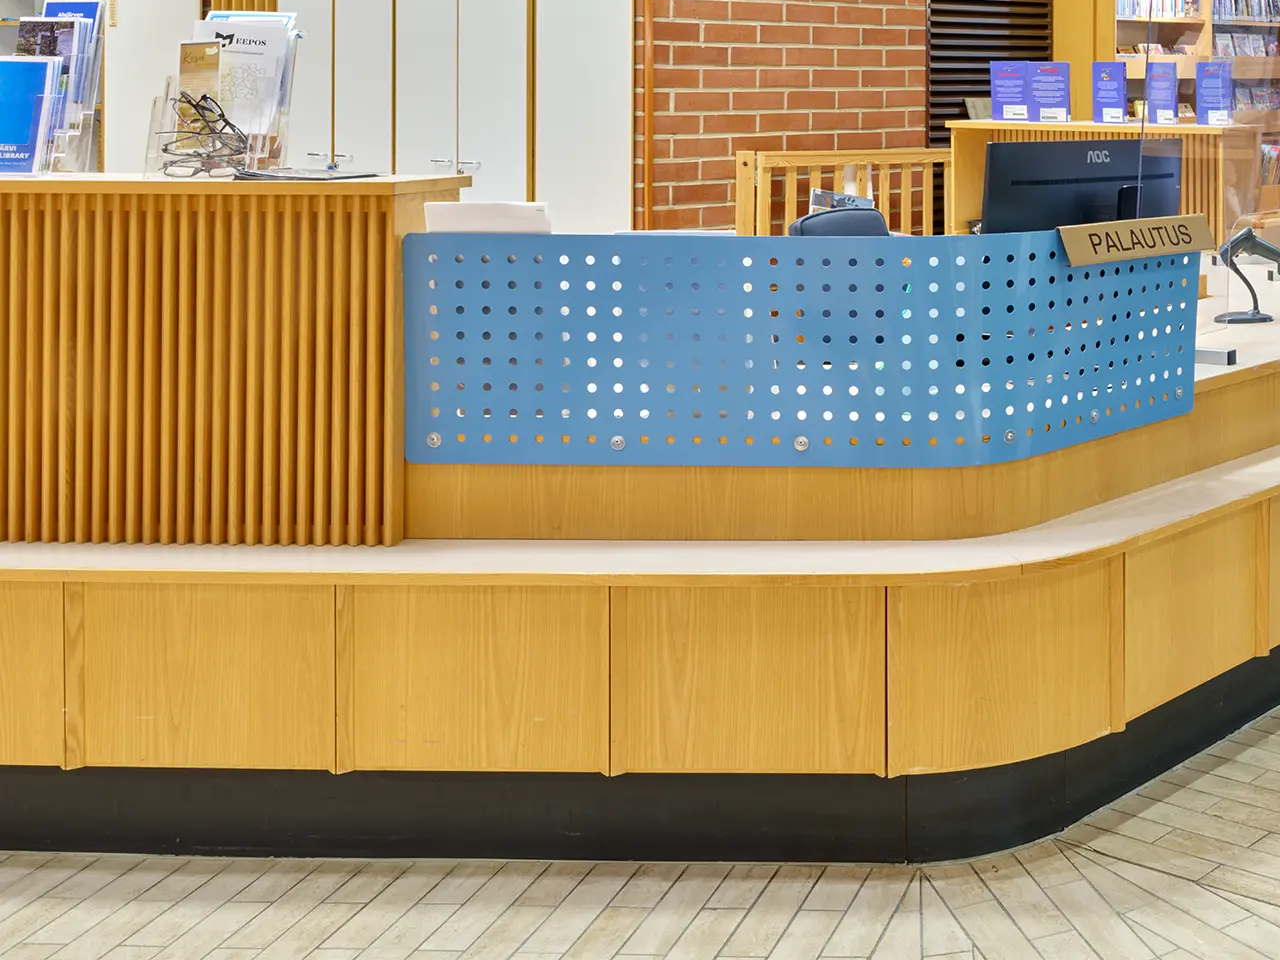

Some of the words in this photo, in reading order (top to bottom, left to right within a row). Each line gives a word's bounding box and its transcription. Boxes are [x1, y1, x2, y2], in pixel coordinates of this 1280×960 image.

[235, 38, 267, 46] EEPOS
[1086, 150, 1111, 164] AOC
[1088, 224, 1192, 255] PALAUTUS
